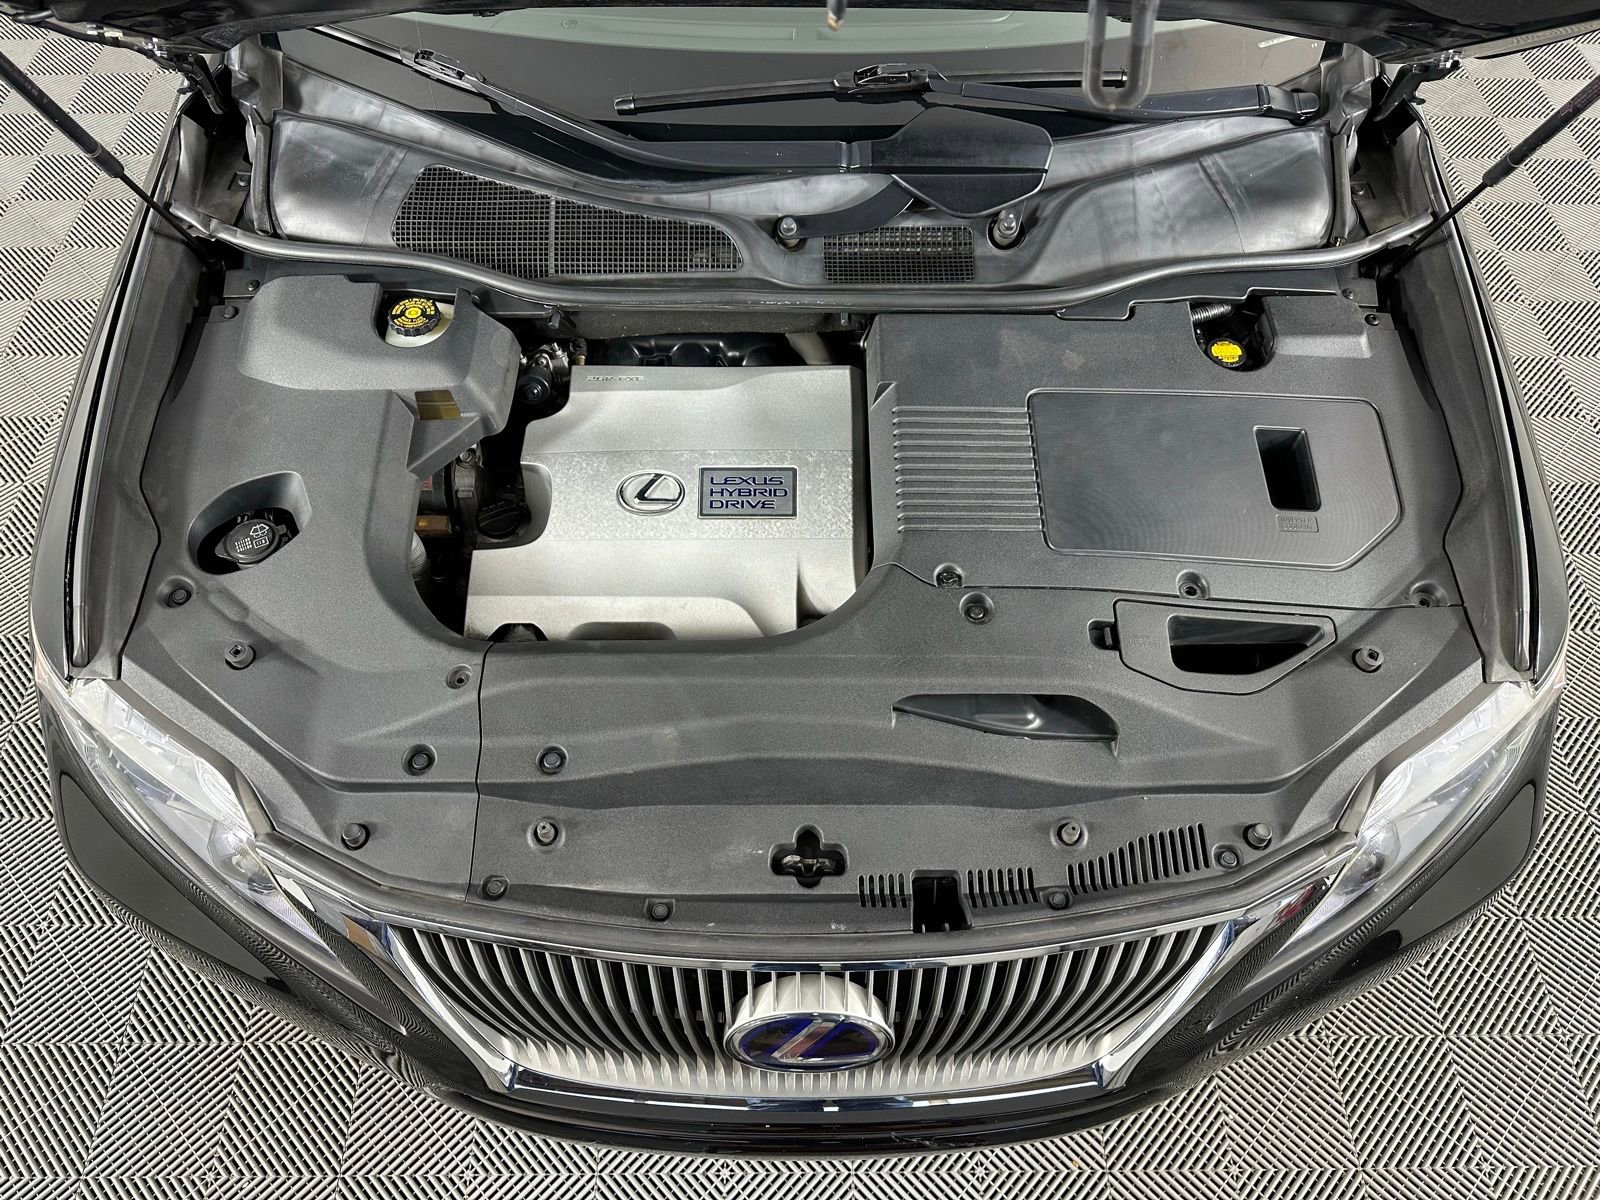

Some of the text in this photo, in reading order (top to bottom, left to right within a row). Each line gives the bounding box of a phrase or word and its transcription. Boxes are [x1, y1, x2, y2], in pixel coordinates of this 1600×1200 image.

[710, 476, 784, 486] LEXUS
[709, 488, 788, 497] HYBRID
[709, 500, 776, 509] DRIVE
